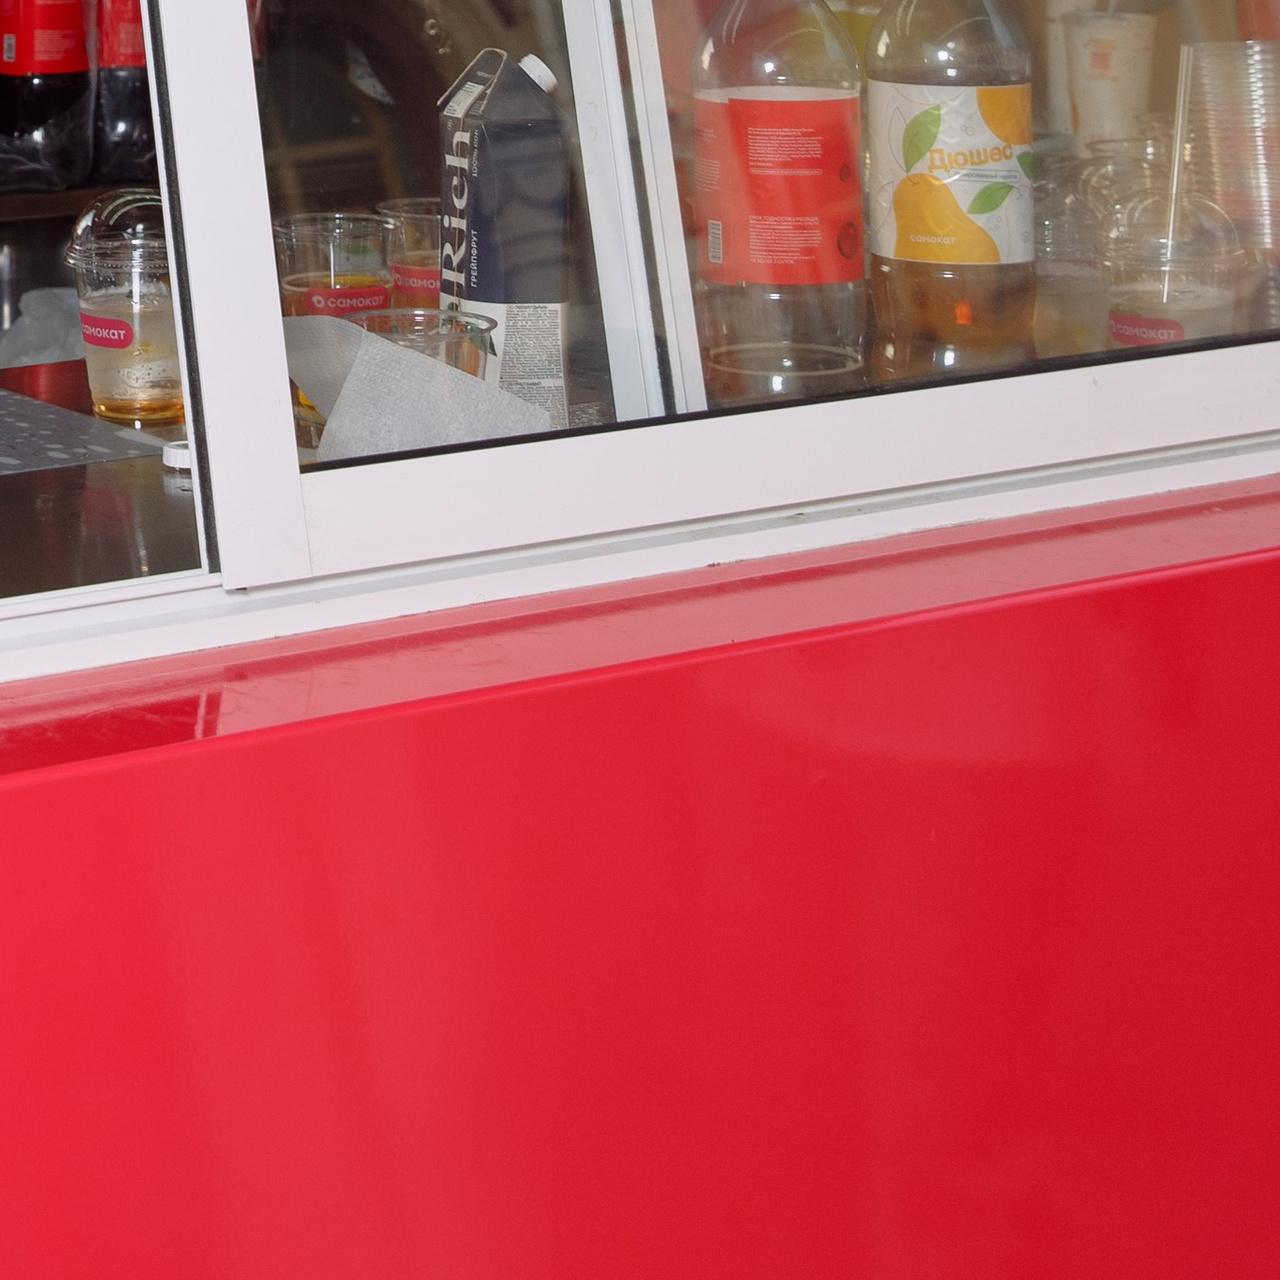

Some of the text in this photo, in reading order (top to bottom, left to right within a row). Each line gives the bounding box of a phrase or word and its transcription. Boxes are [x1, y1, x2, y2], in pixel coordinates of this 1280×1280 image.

[927, 144, 1014, 174] Дюшес
[441, 130, 470, 288] Rich
[328, 296, 384, 308] самокат
